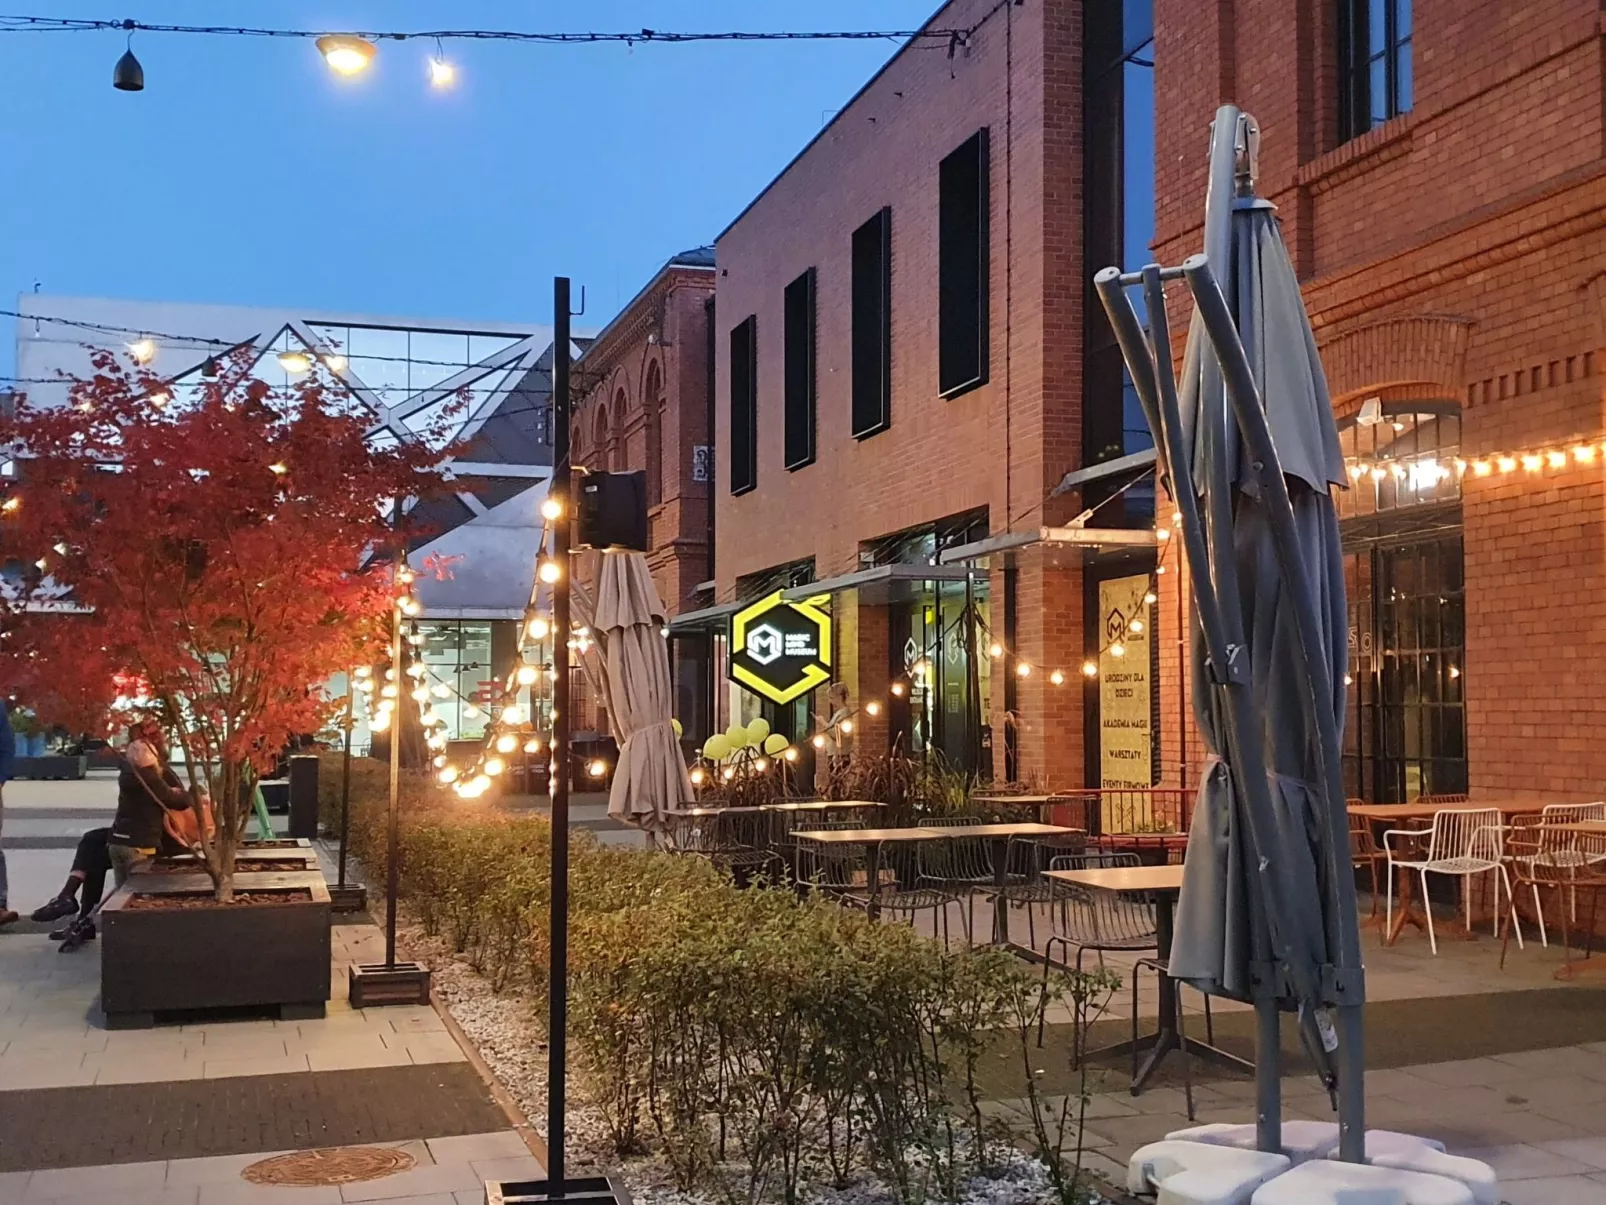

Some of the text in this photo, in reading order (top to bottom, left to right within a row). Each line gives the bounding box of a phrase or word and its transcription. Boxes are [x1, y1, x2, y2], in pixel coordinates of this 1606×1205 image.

[1105, 673, 1144, 683] URODZINY DLA
[1103, 719, 1130, 729] AKADEMIA
[1109, 749, 1141, 760] WARSZTATY
[1102, 779, 1122, 789] EVENTY
